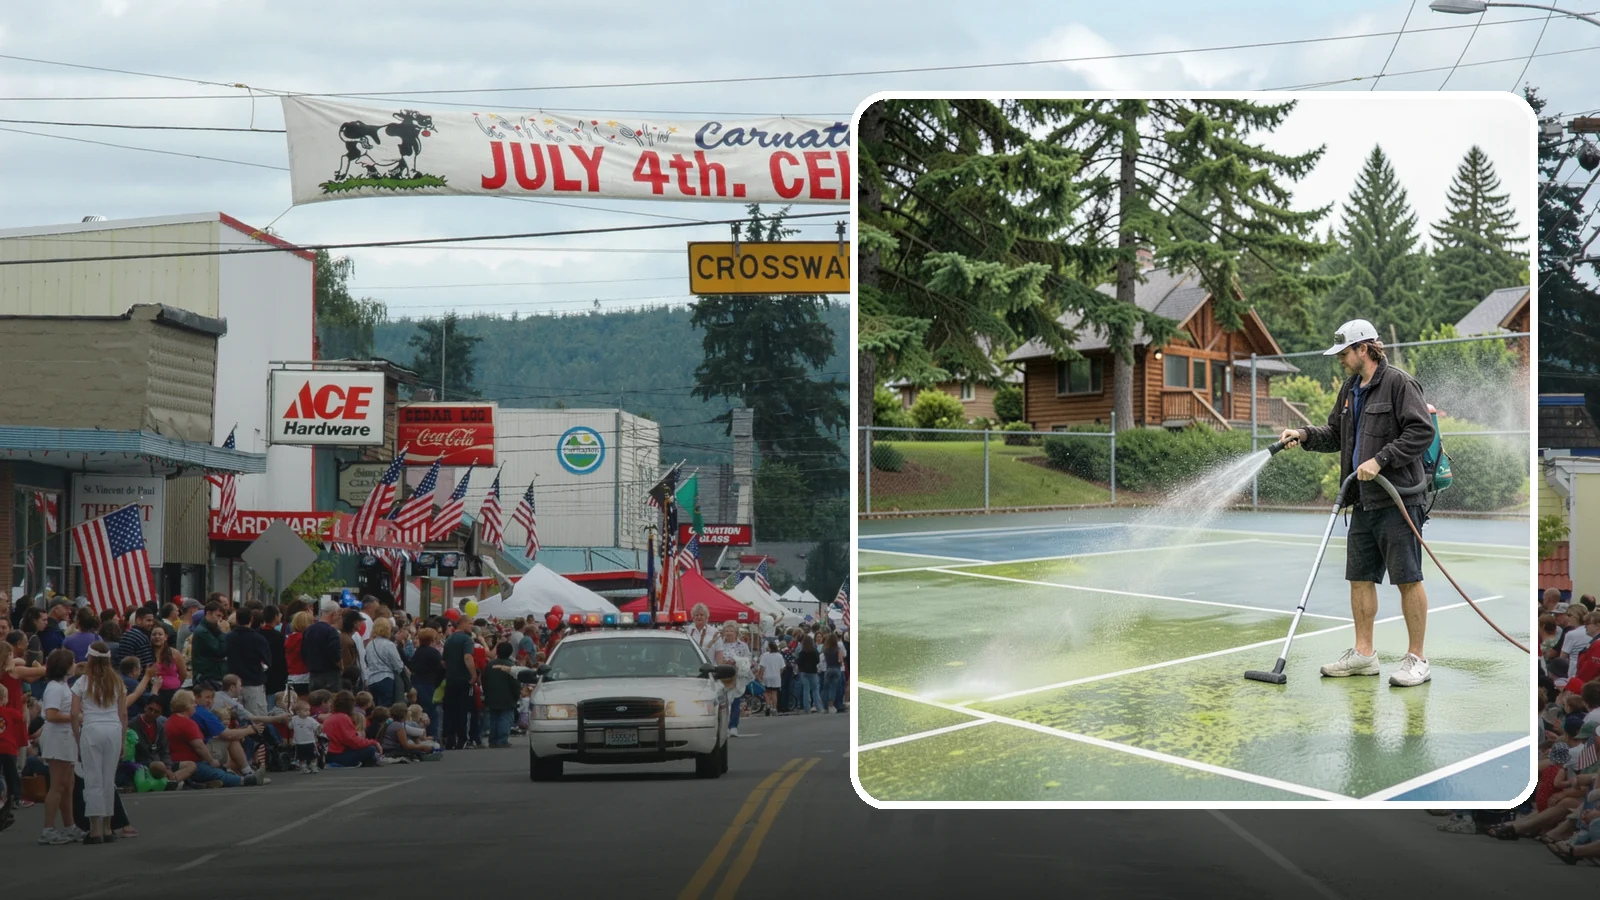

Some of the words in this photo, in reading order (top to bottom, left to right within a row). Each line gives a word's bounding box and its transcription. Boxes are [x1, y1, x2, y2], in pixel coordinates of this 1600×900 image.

[481, 141, 605, 192] JULY
[632, 150, 746, 198] 4th.
[697, 254, 850, 280] CROSSWA
[283, 380, 373, 420] ACE
[405, 409, 452, 421] CEDAR
[283, 421, 371, 436] Hardware
[416, 428, 477, 447] Coca-Cola
[83, 485, 94, 494] St.
[96, 485, 124, 495] Vincent
[126, 486, 136, 495] de
[138, 485, 155, 495] Paul
[688, 526, 741, 535] CRNATION
[699, 535, 730, 543] GLASS
